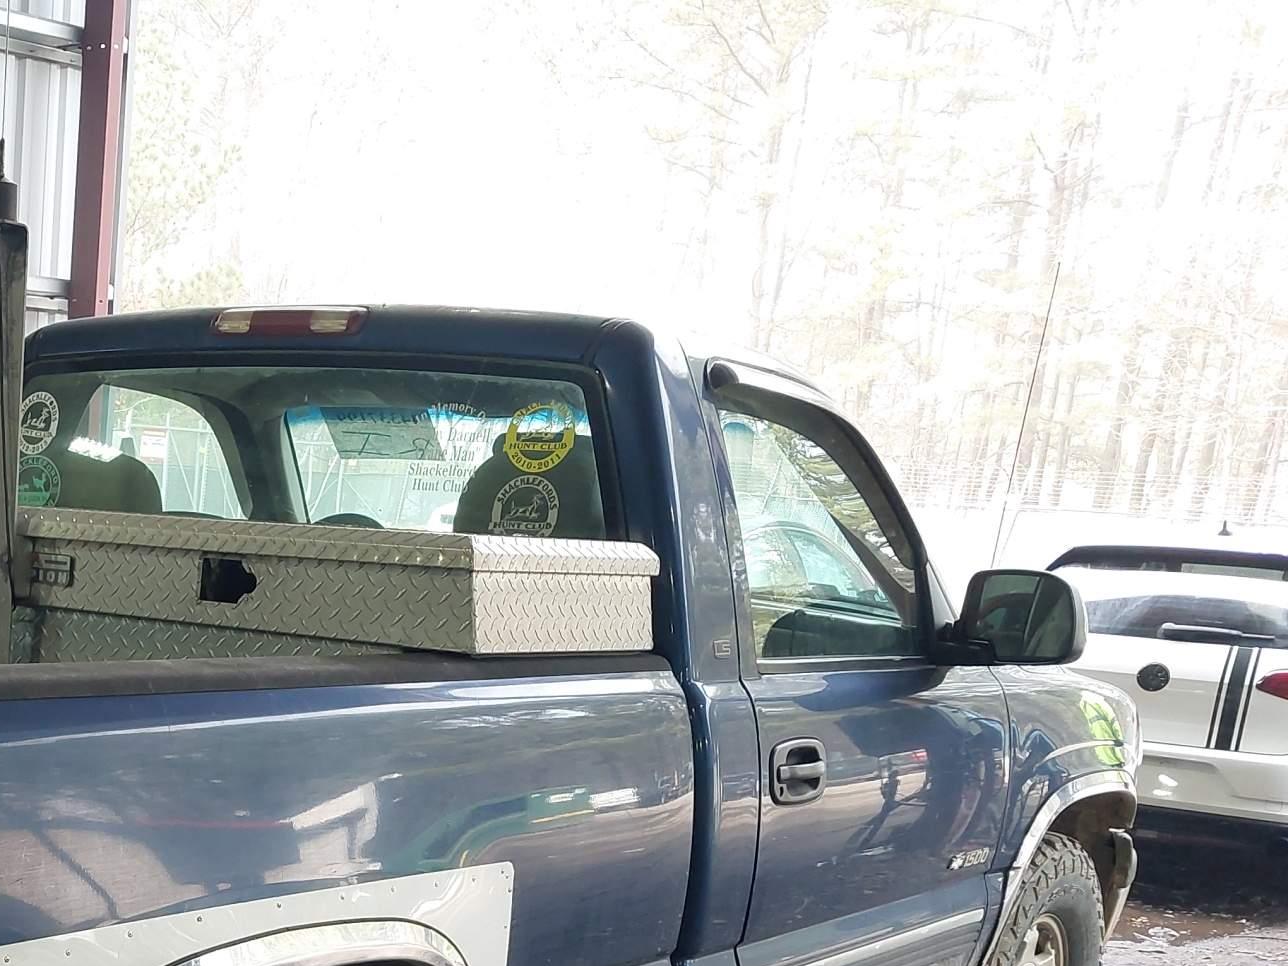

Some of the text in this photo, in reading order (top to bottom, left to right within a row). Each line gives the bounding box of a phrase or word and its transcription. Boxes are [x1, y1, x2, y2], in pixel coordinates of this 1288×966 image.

[509, 442, 568, 450] HUNT CLUB
[511, 451, 561, 470] 2010-2011
[412, 478, 469, 493] Hunt Club
[497, 476, 558, 510] SHACKLEFORDS
[493, 521, 553, 530] HUNT CLUB
